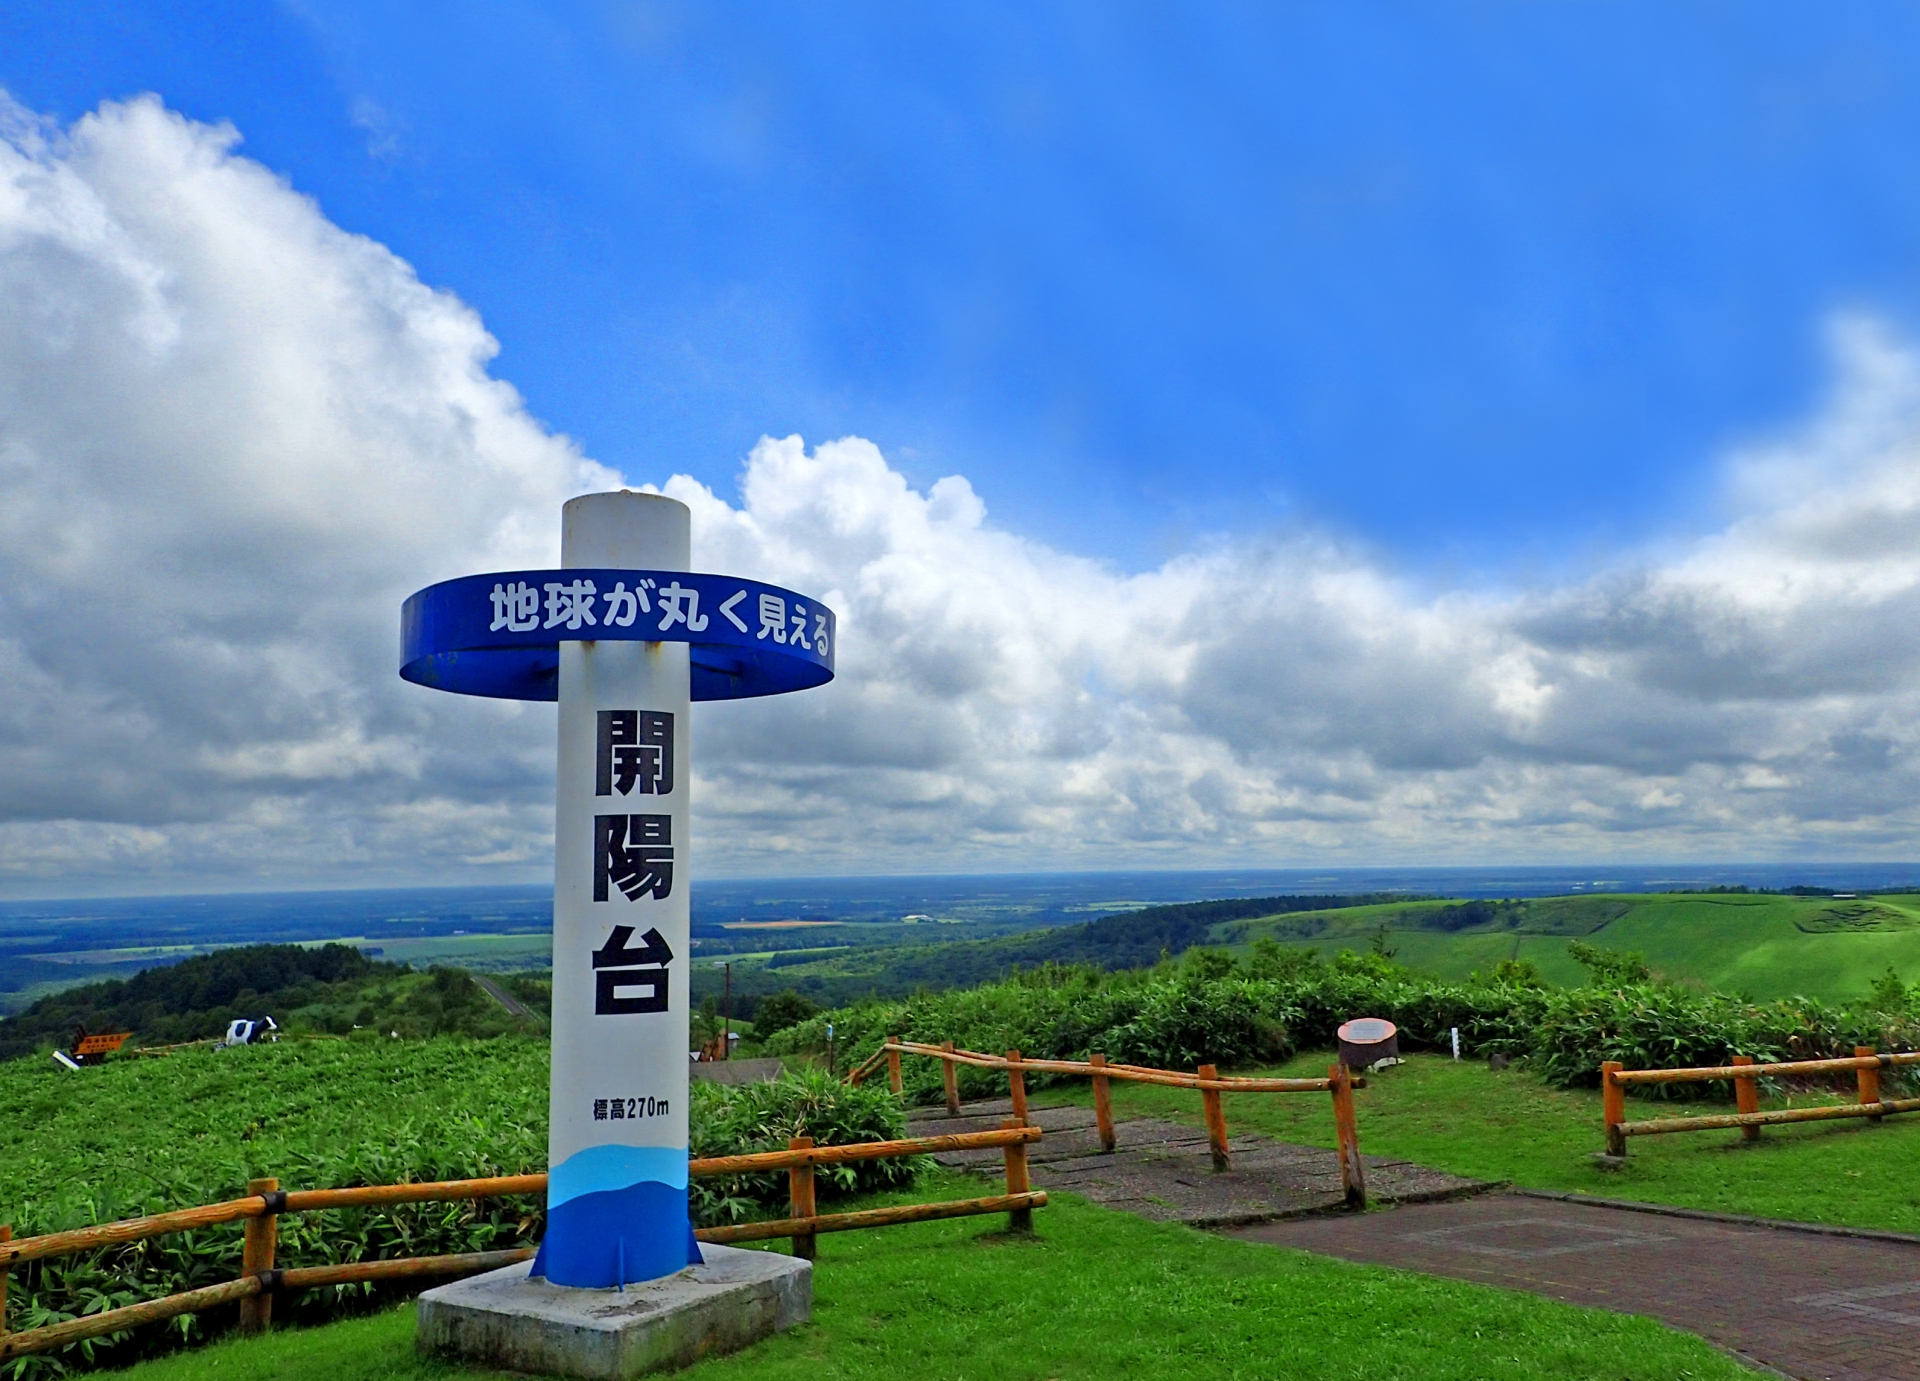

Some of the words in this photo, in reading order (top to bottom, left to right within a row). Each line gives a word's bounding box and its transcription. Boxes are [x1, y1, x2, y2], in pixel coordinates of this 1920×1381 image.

[489, 578, 829, 656] 地球が丸く見える
[592, 710, 674, 1016] 開陽台
[593, 1096, 669, 1120] 標高270m
